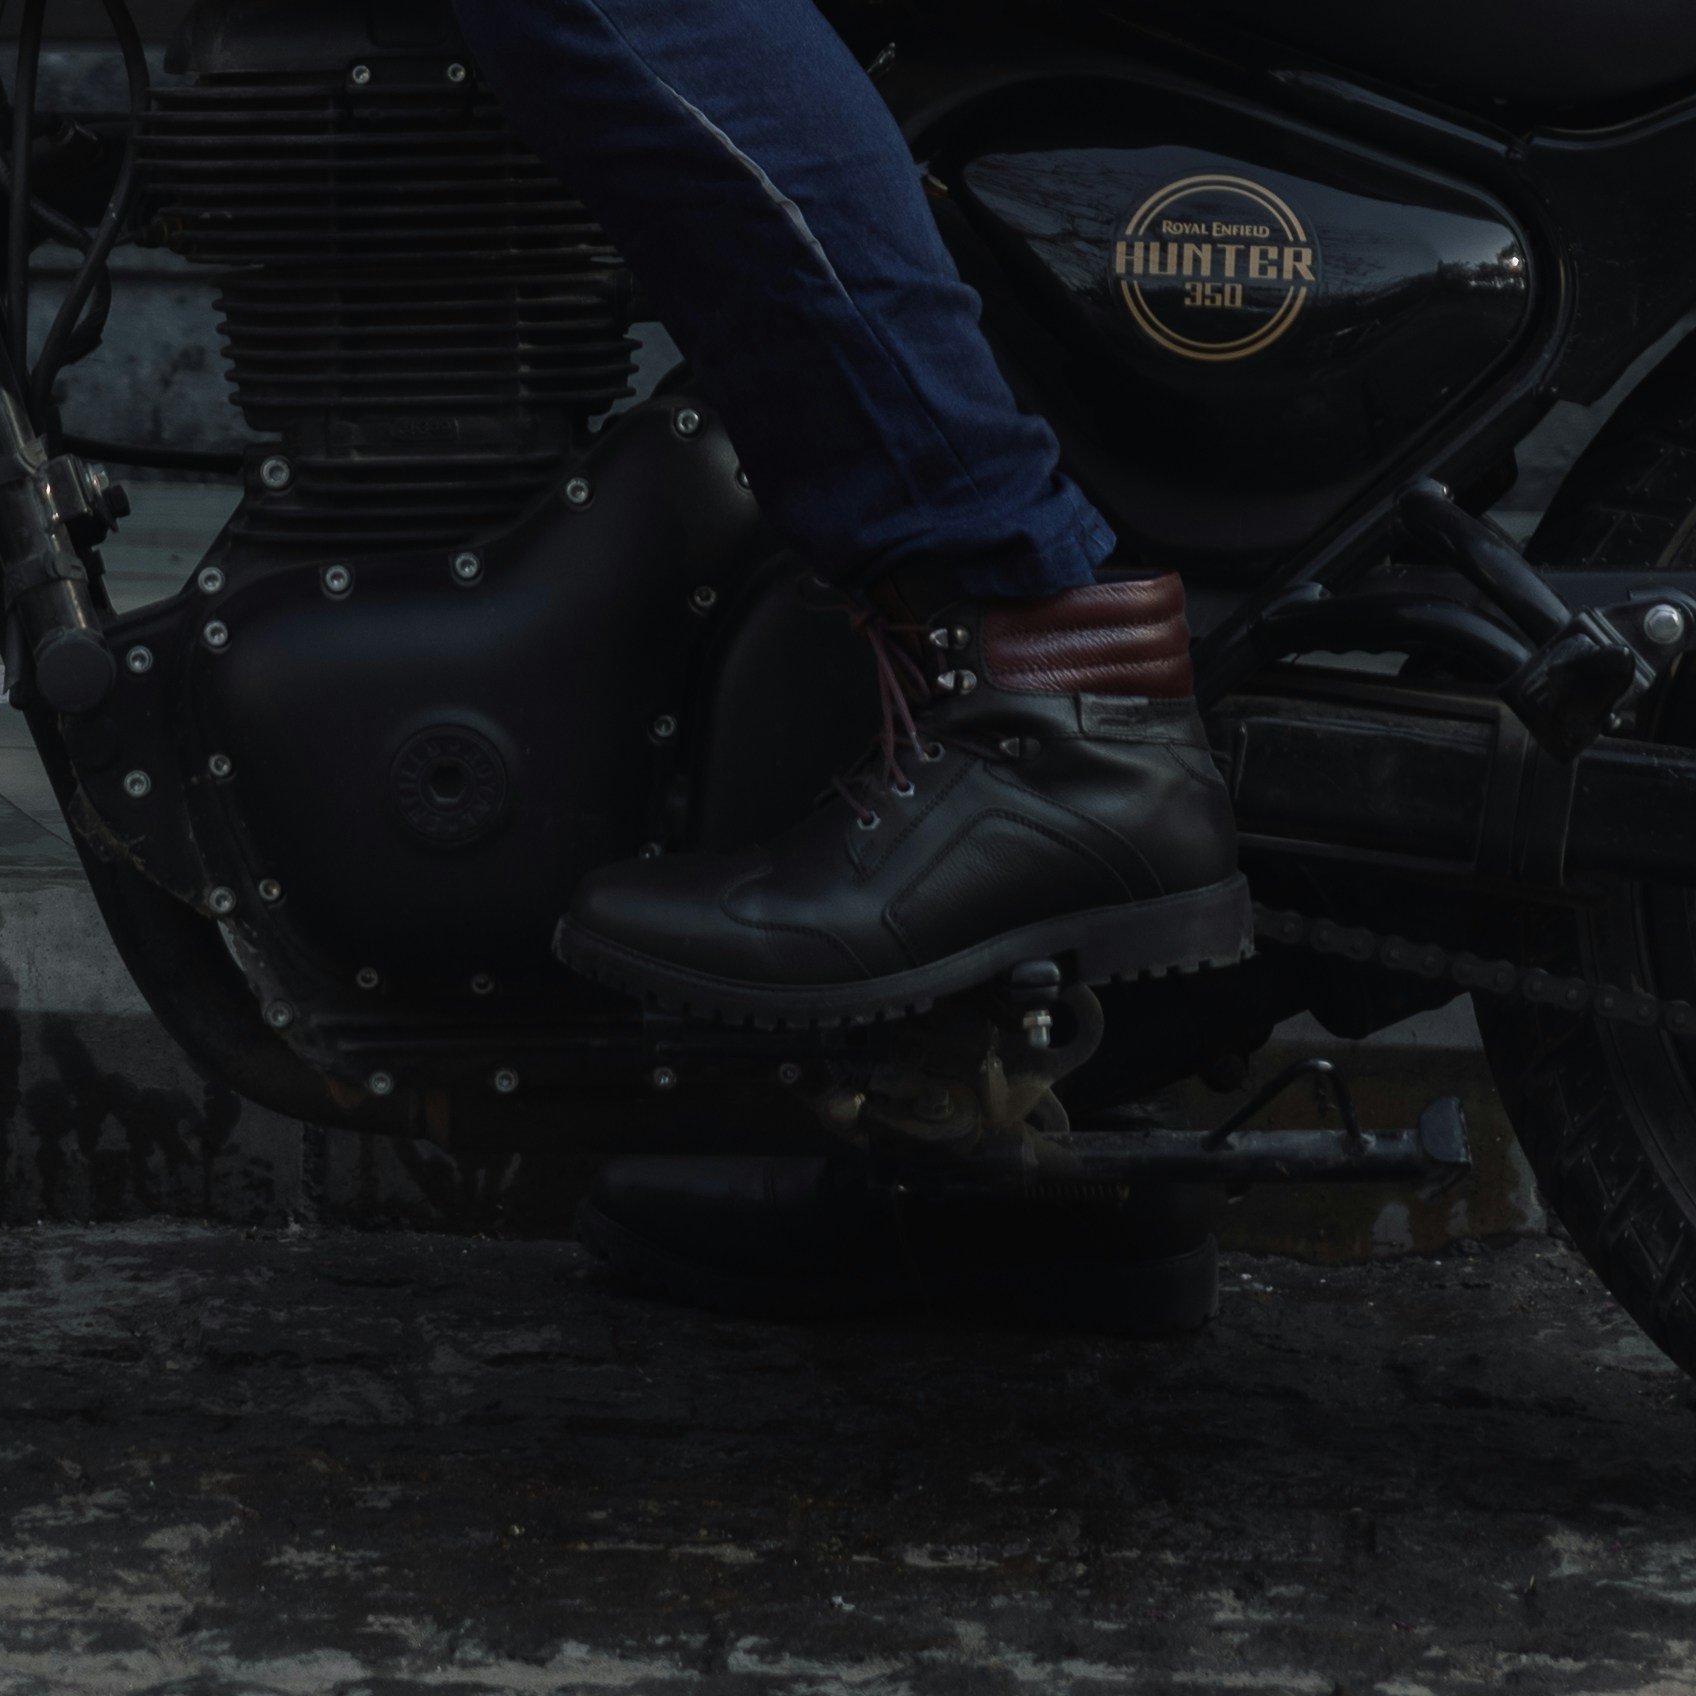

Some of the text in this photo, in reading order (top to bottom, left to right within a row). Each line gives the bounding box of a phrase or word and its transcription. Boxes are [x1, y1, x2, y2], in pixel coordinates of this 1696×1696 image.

[1162, 219, 1271, 238] ROYAL ENFIELD
[1115, 241, 1316, 281] HUNTER
[1184, 281, 1243, 307] 350
